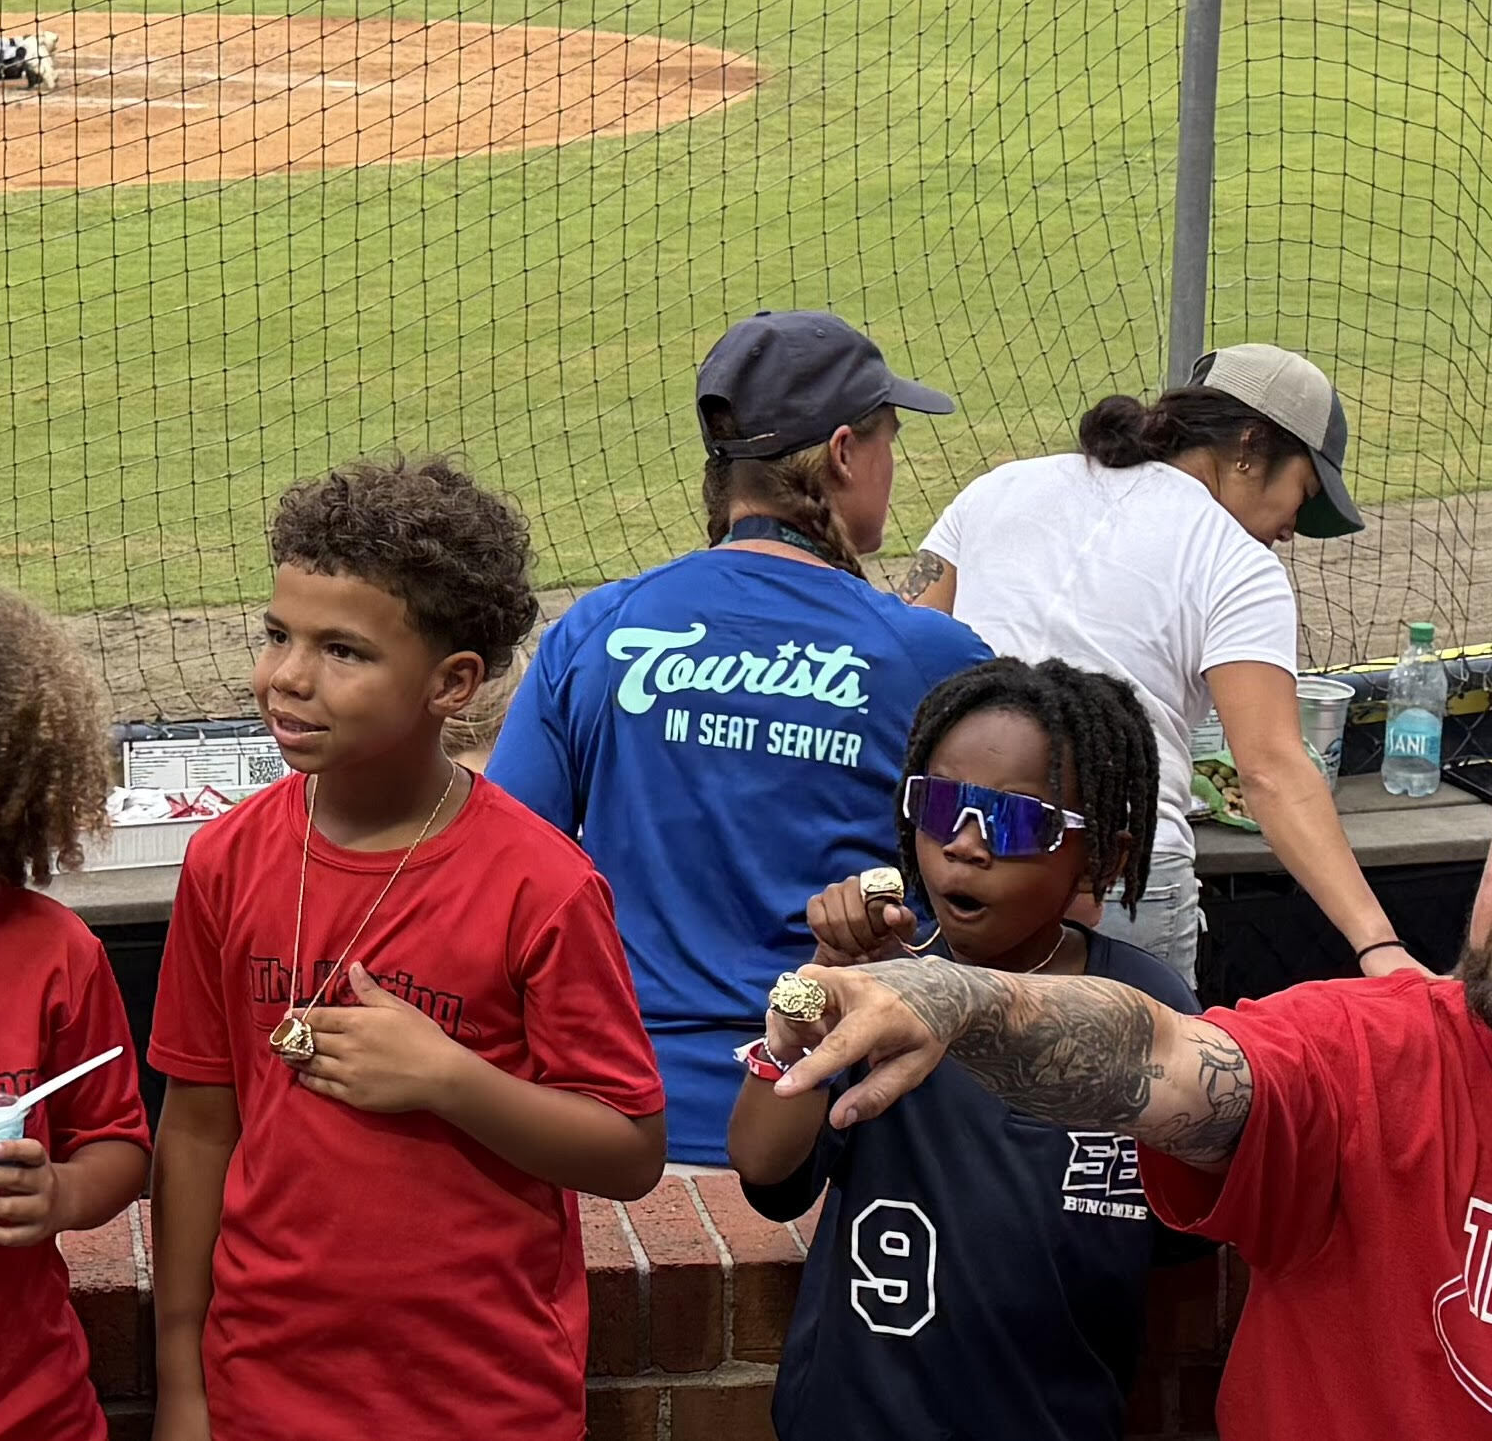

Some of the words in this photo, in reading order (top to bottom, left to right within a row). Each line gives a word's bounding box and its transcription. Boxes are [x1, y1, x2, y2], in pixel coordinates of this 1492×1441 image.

[606, 622, 871, 714] Tourists
[665, 708, 690, 743] IN
[698, 713, 760, 751] SEAT
[766, 722, 863, 768] SERVER
[850, 1198, 938, 1338] 9
